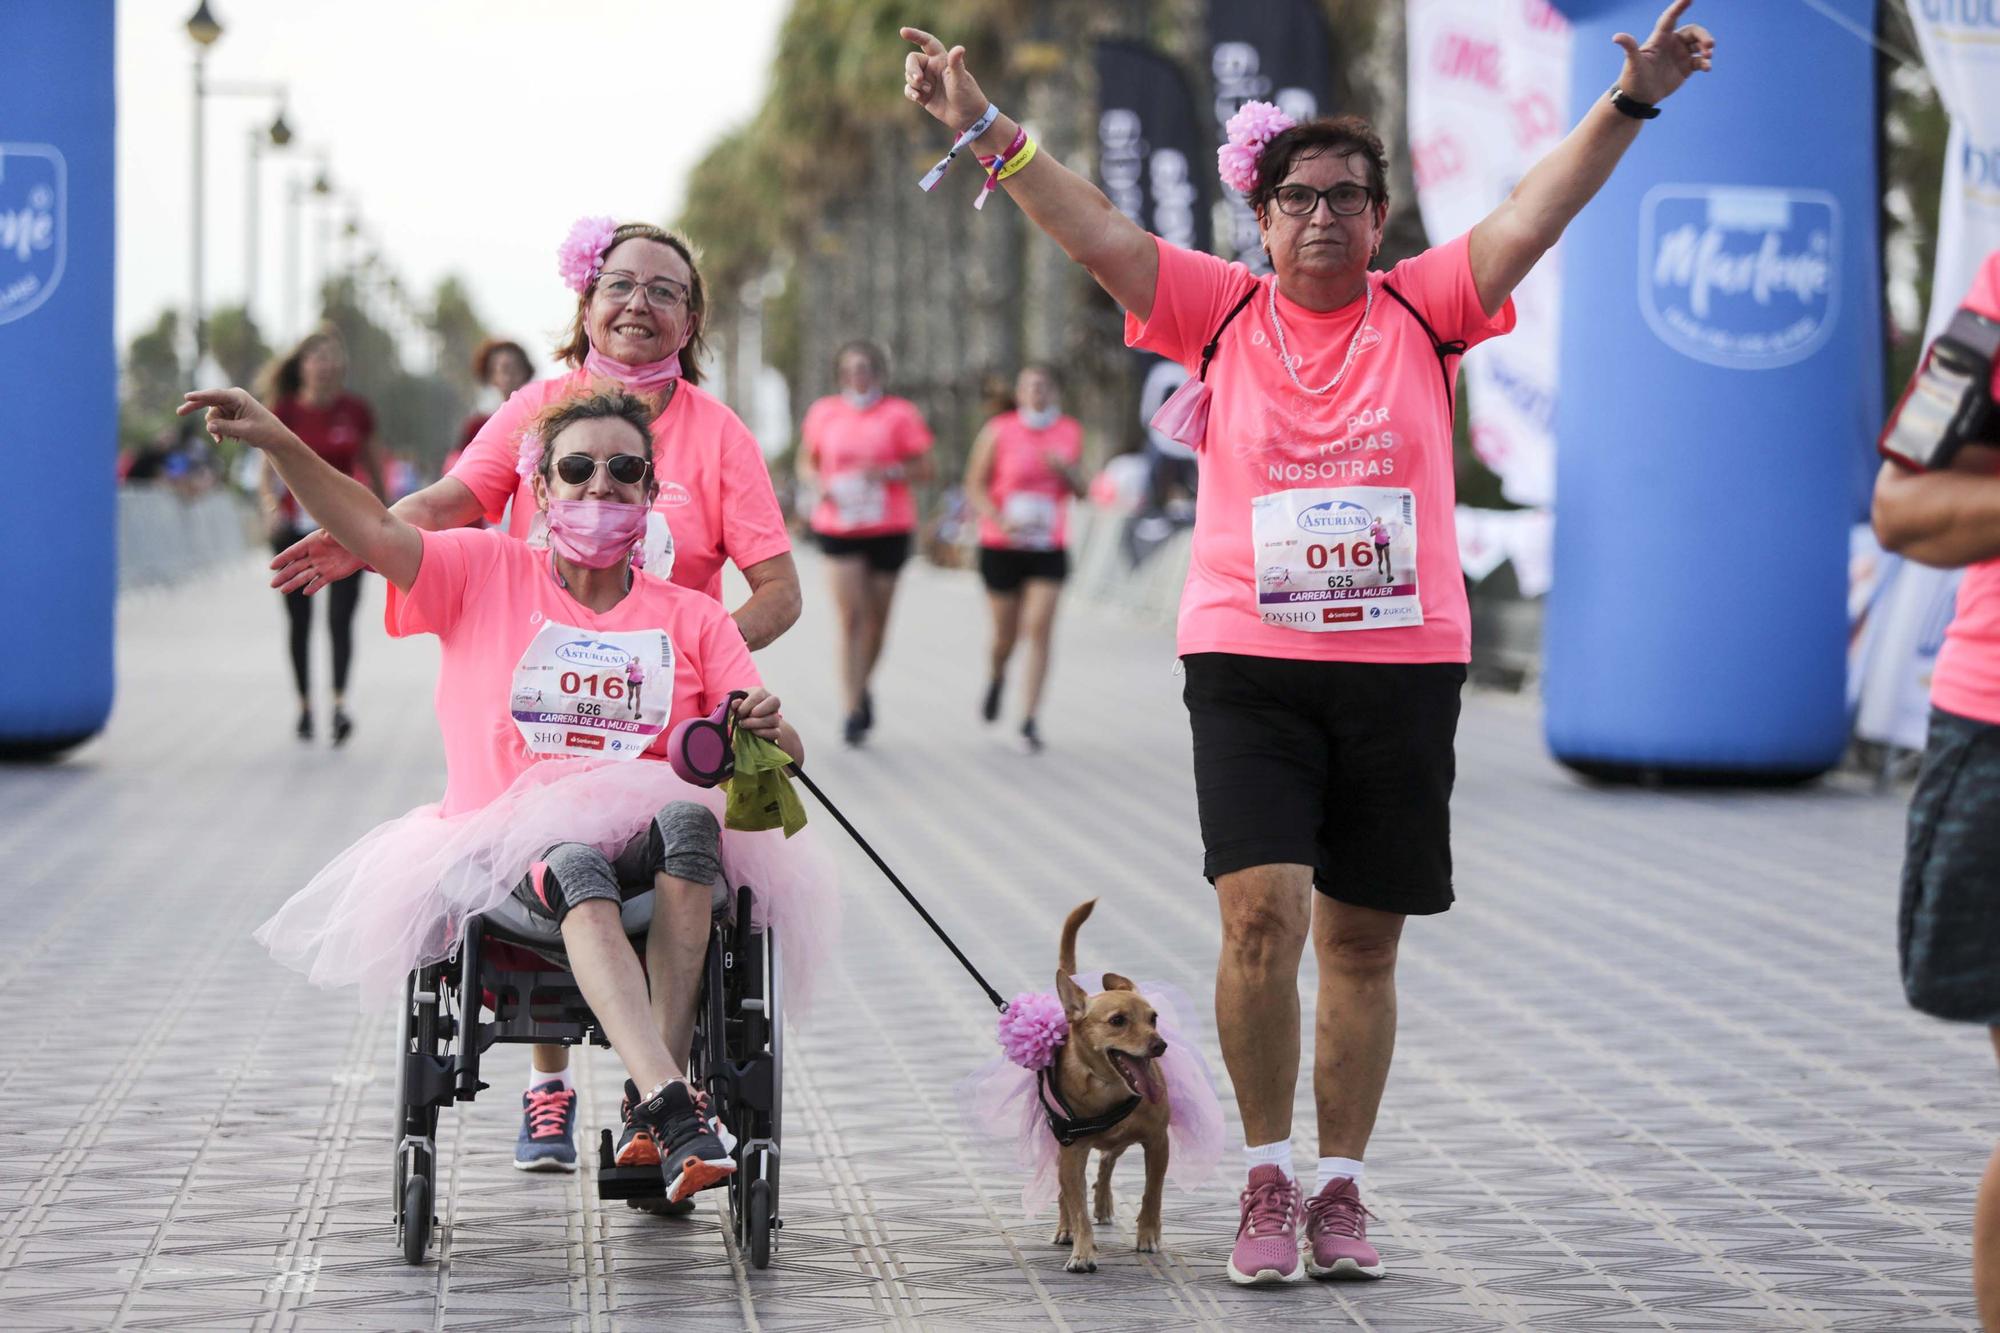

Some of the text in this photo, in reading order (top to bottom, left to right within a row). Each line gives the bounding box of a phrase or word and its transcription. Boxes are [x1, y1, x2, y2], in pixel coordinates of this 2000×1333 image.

[1346, 407, 1391, 433] POR
[1318, 431, 1394, 457] TODAS
[1268, 458, 1394, 481] NOSOTRAS
[1304, 513, 1368, 528] ASTURIANA
[1306, 541, 1374, 569] 016
[1327, 575, 1354, 588] 625
[1289, 586, 1394, 602] CARRERA DE LA MUJER
[562, 647, 625, 664] ASTURIANA
[560, 671, 624, 699] 016
[576, 702, 601, 716] 626
[539, 713, 640, 732] CARRERA DE LA MUJER
